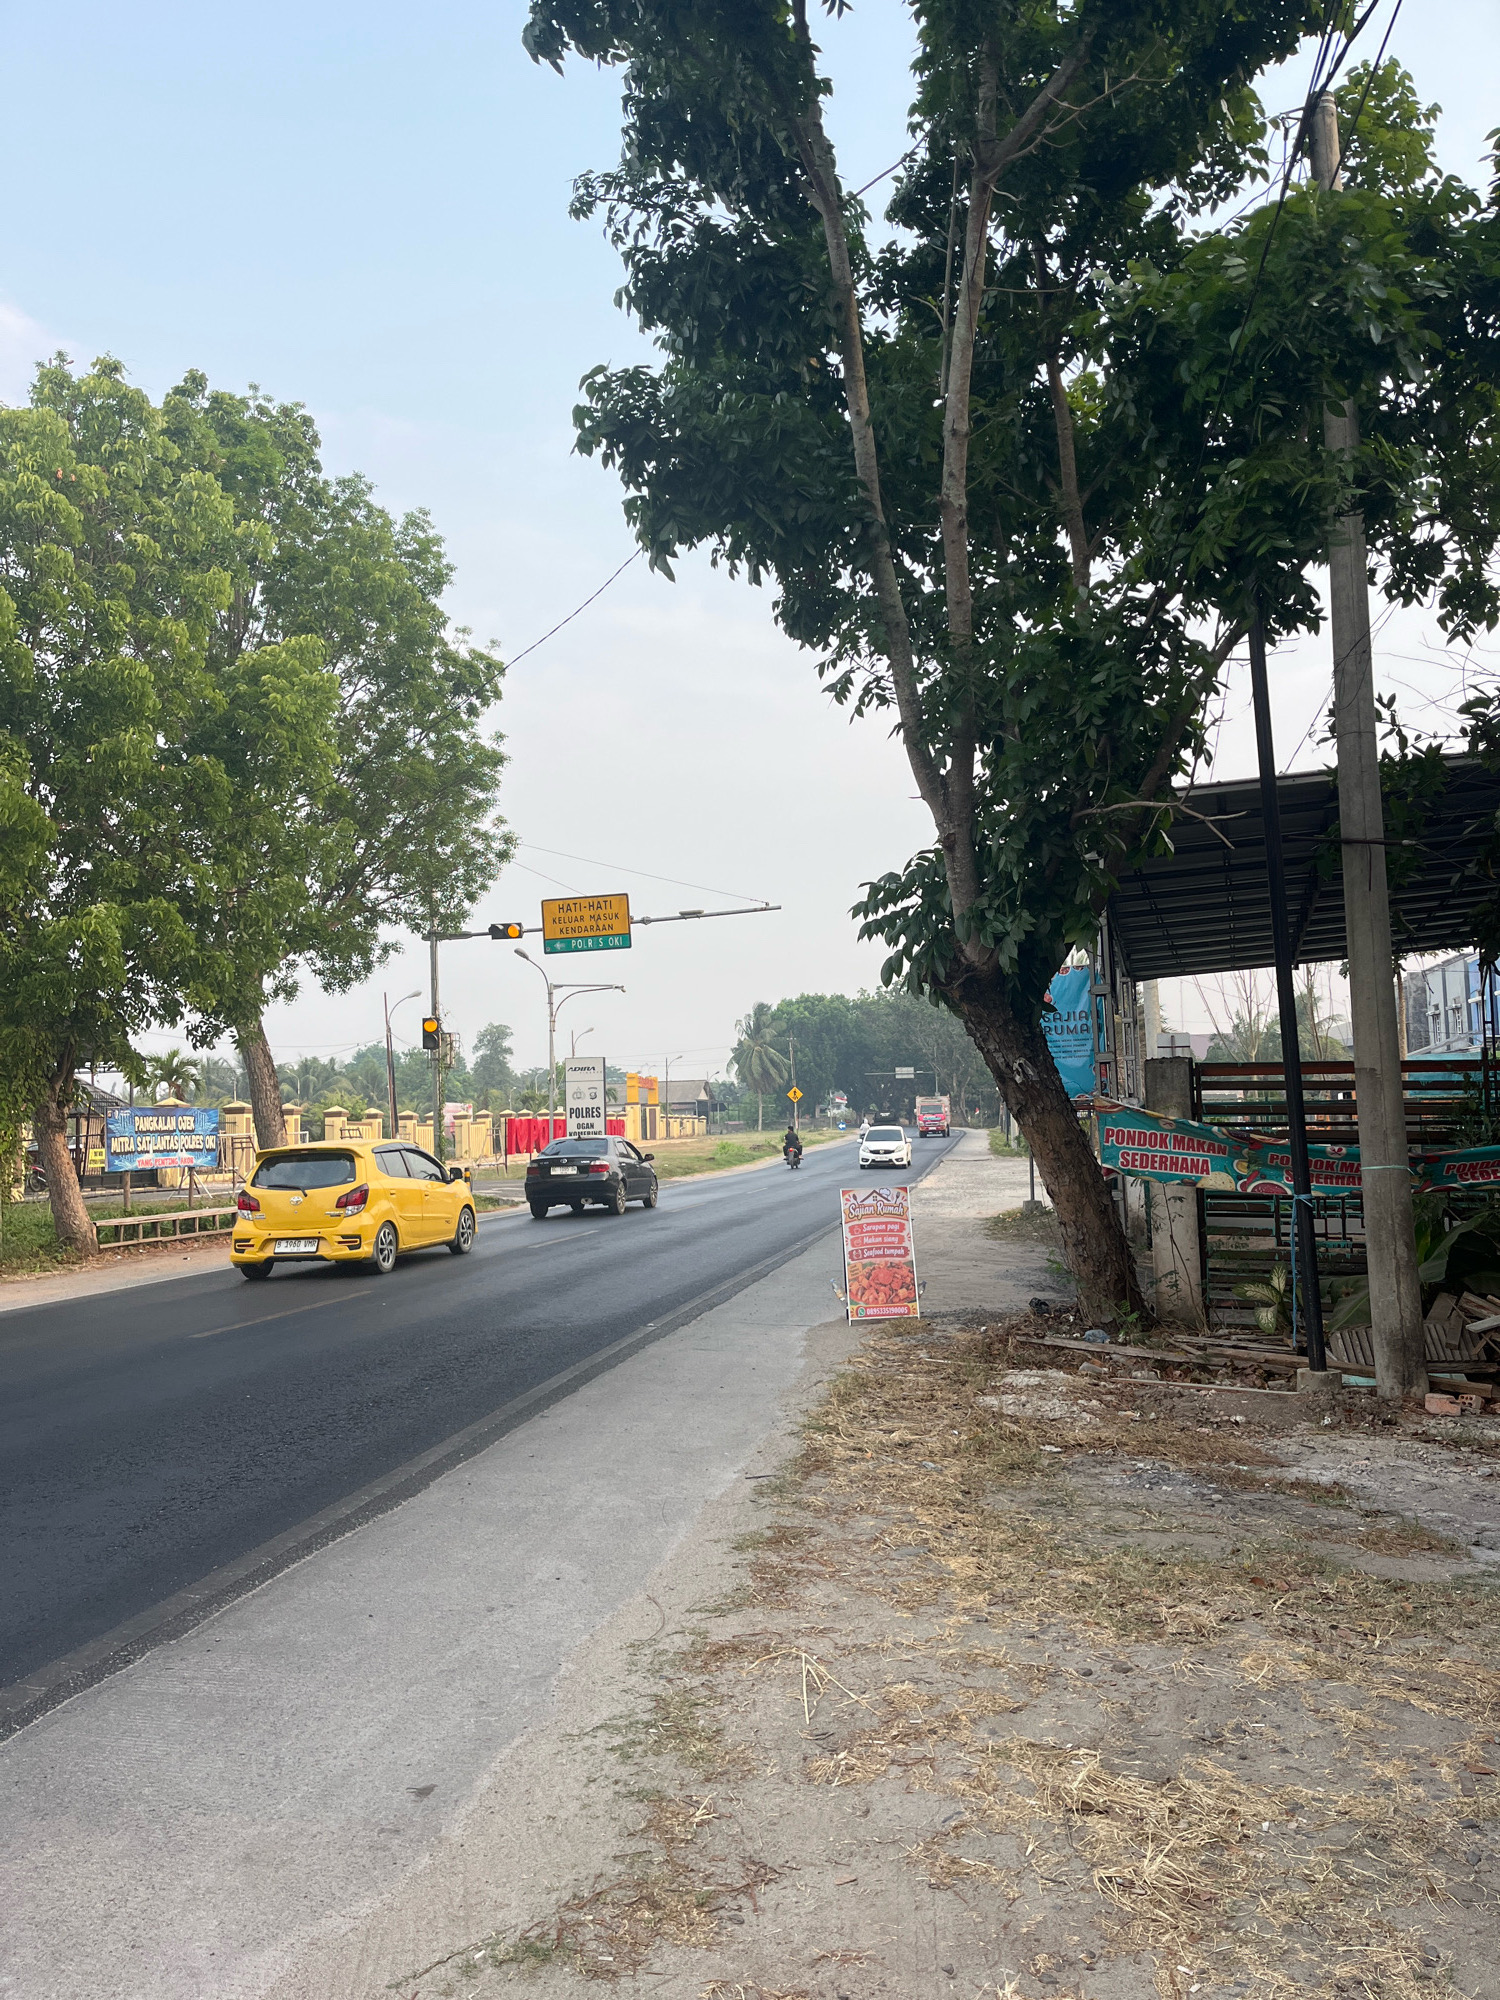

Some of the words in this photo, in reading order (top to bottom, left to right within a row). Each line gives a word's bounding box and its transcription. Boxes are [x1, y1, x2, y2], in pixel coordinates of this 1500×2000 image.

[558, 900, 613, 914] HATI-HATI
[552, 916, 585, 925] KELUAR
[589, 912, 619, 922] MASUK
[559, 924, 614, 935] KENDARAAN
[608, 936, 622, 946] OKI
[1043, 1010, 1090, 1023] SAJIA
[1043, 1023, 1090, 1036] RUMA
[569, 1106, 601, 1119] POLRES
[134, 1116, 176, 1132] PANGKALAN
[177, 1115, 195, 1132] OJEK
[576, 1122, 595, 1130] OGAN
[111, 1136, 135, 1153] MITRA
[136, 1136, 151, 1152] SAT
[152, 1135, 179, 1151] LANTAS
[180, 1134, 204, 1151] POLRES
[205, 1134, 216, 1150] OKI
[1103, 1127, 1170, 1150] PONDOK
[1172, 1134, 1228, 1156] MAKAN
[137, 1158, 153, 1168] YANG
[154, 1157, 178, 1167] PENTING
[1120, 1151, 1211, 1176] SEDERHANA
[1268, 1153, 1336, 1172] POOK
[848, 1203, 875, 1219] Sajian
[876, 1200, 904, 1216] Rumah
[862, 1224, 886, 1232] Sarapan
[887, 1223, 900, 1232] pagi
[883, 1236, 899, 1244] siang
[863, 1247, 884, 1257] Seafood
[884, 1247, 905, 1256] tumpah
